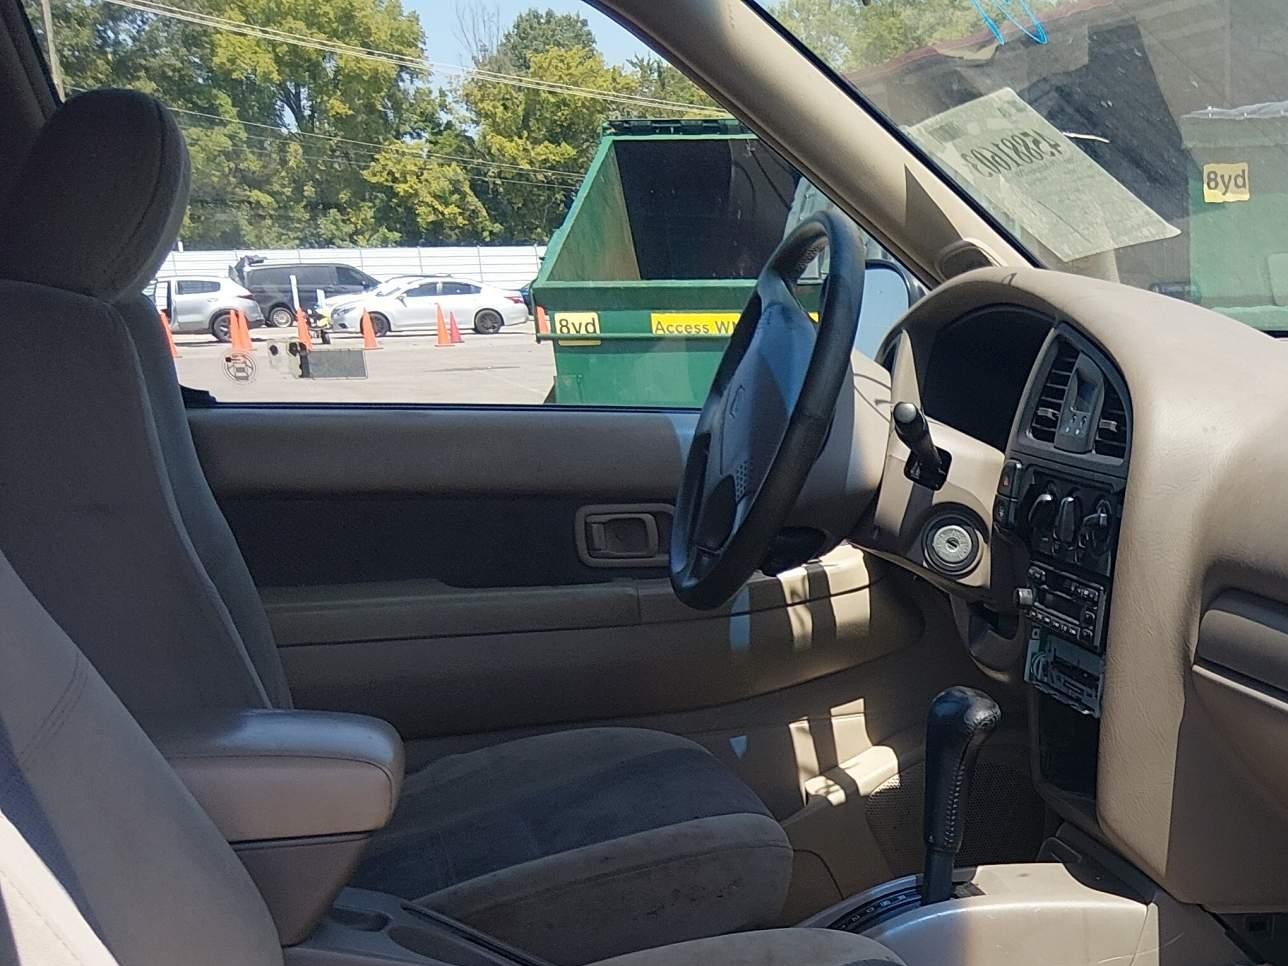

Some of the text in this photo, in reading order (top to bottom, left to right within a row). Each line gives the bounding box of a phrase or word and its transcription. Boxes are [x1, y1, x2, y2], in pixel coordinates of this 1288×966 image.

[1206, 168, 1247, 195] 8yd
[654, 319, 736, 334] Access W
